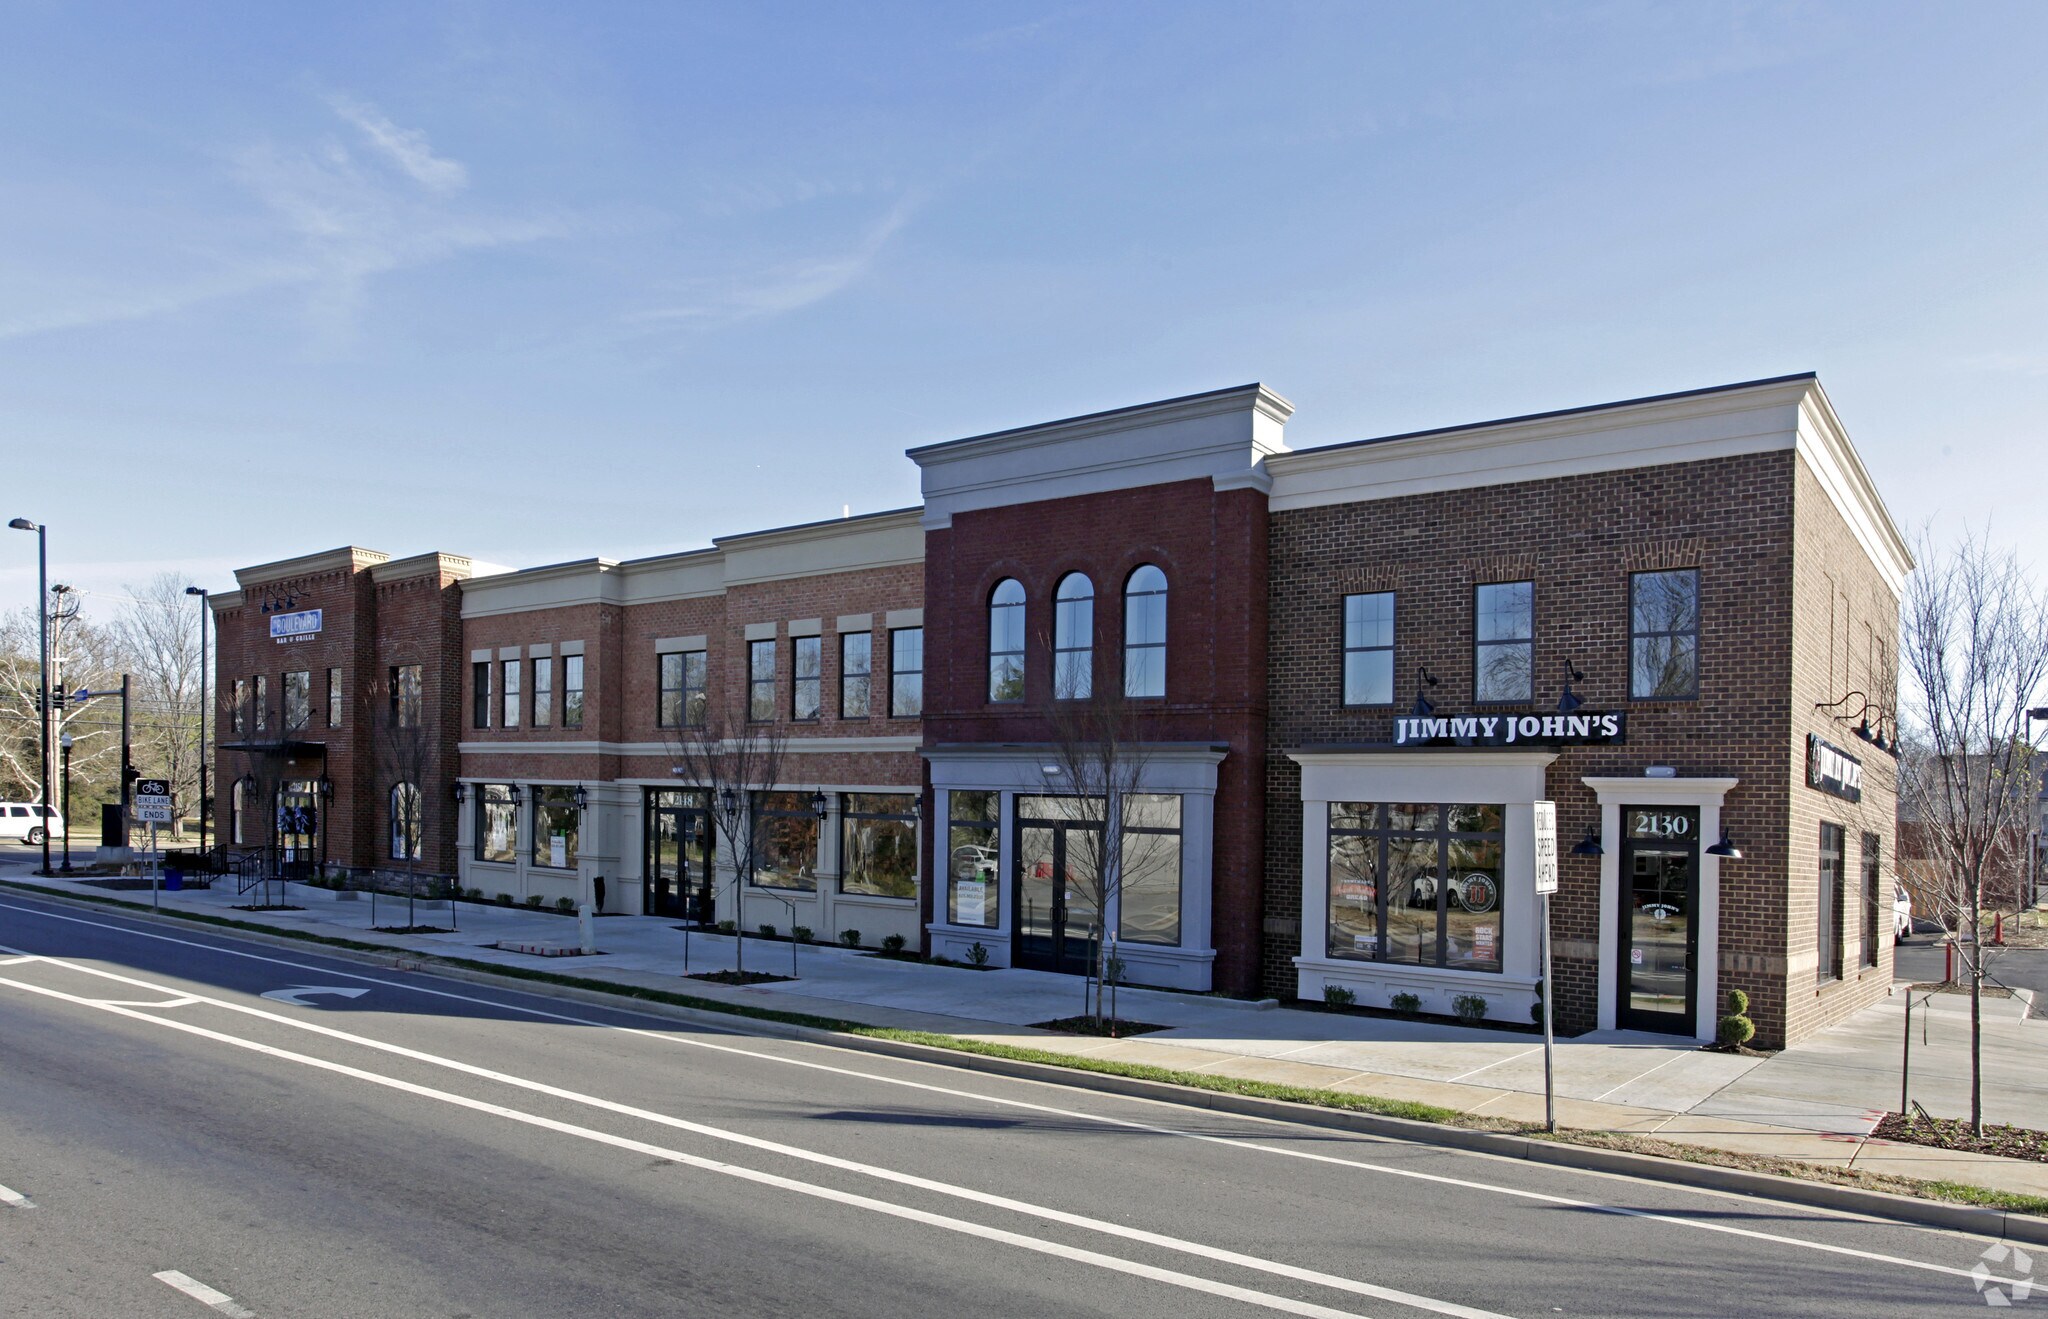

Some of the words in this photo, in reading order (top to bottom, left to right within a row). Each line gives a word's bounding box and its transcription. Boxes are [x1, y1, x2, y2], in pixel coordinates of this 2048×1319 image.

[276, 613, 318, 634] BOULEVARD
[295, 634, 316, 642] GRILLE
[1397, 717, 1499, 744] JIMMY
[1505, 714, 1619, 742] JOHN'S
[138, 796, 152, 804] BIKE
[153, 796, 169, 804] LANE
[144, 810, 165, 819] ENDS
[1635, 815, 1689, 836] 2130
[1537, 837, 1555, 857] SPEED
[1538, 863, 1556, 883] AHEAD
[1461, 876, 1477, 894] JIMMY
[1641, 903, 1660, 911] JIMMY
[1475, 926, 1493, 934] ROCK
